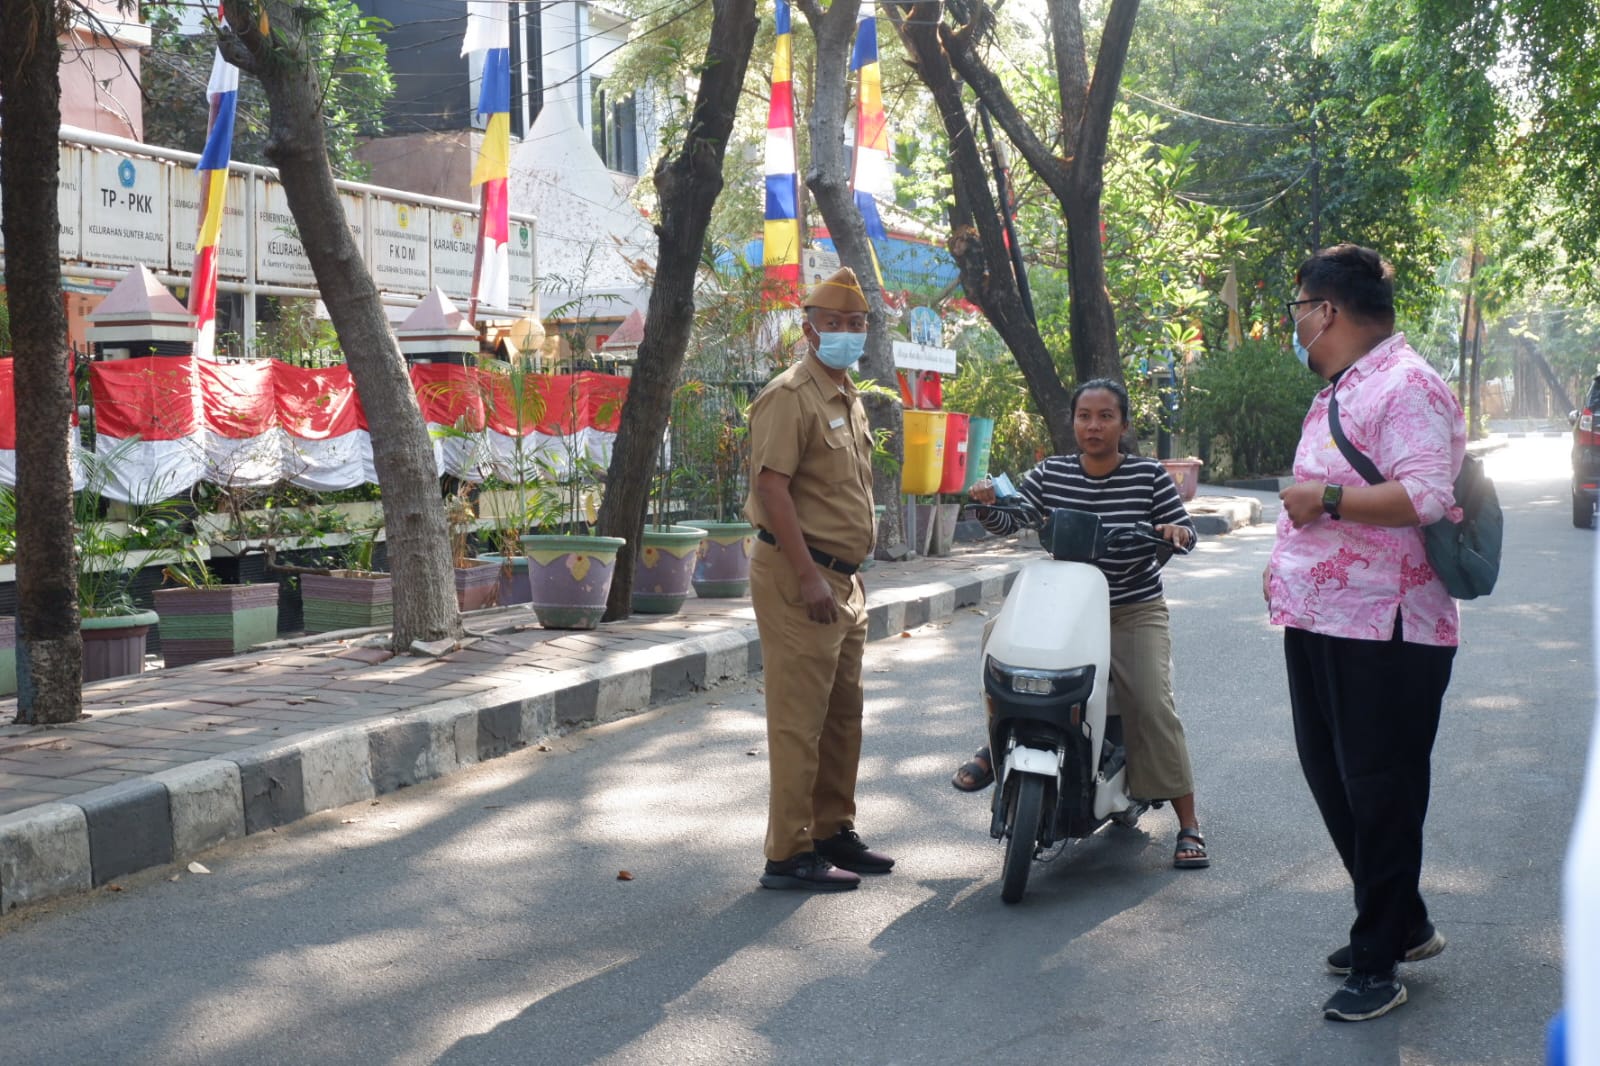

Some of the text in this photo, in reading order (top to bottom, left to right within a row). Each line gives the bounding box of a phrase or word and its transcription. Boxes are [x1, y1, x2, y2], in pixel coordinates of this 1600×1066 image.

[101, 188, 117, 208] TP
[128, 193, 152, 214] PKK
[60, 224, 74, 235] UNG
[88, 224, 164, 242] KELURAHAN SUNTER AGUNG
[176, 241, 196, 251] KELURA
[434, 239, 459, 253] KARANG
